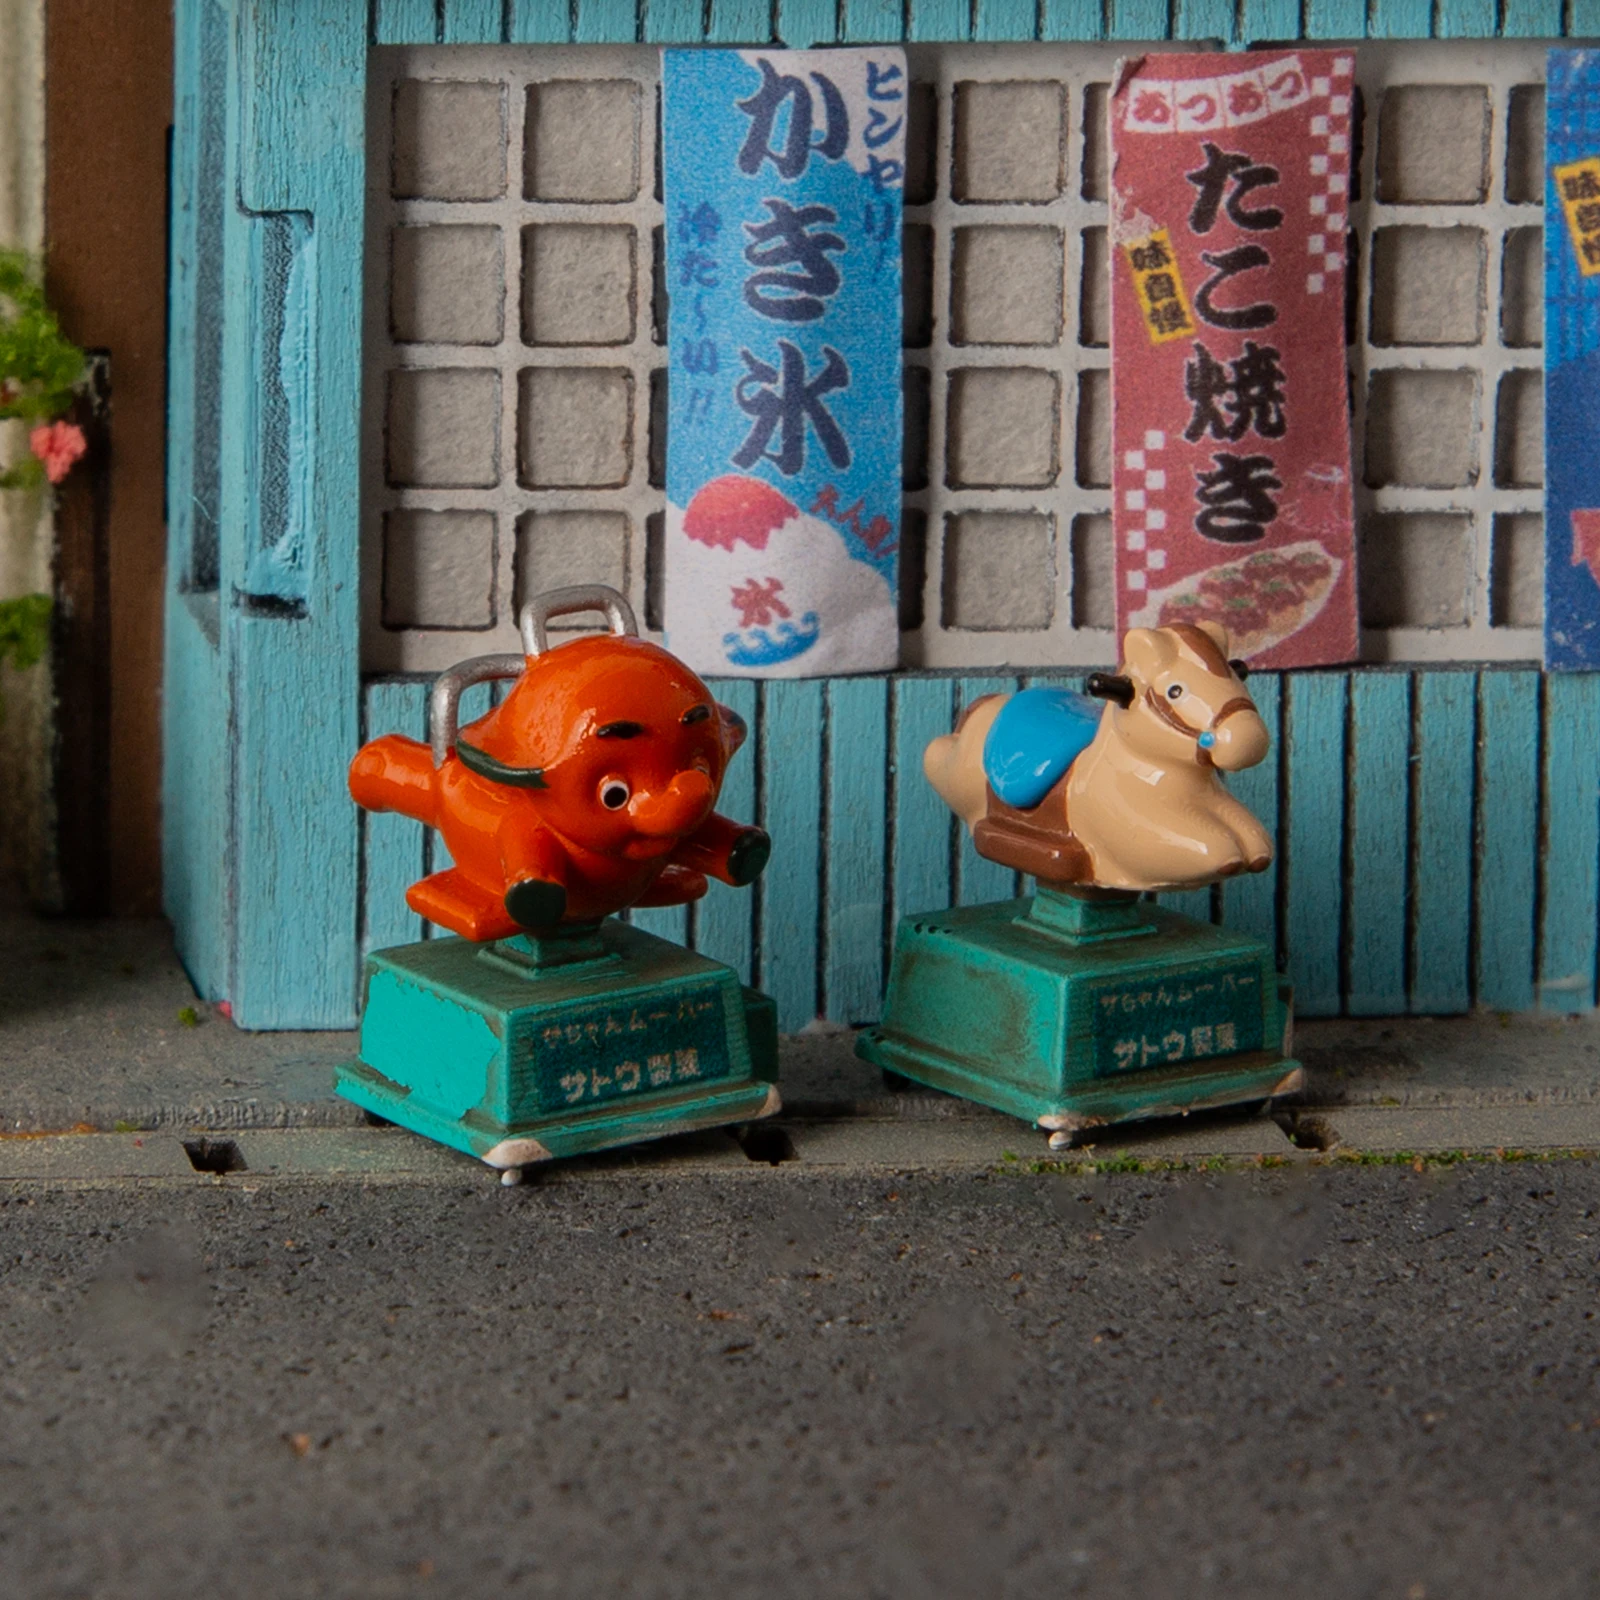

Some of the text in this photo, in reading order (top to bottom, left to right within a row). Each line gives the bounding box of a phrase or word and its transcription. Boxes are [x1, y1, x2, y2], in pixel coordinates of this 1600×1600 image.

[731, 57, 852, 476] かき氷
[1184, 141, 1287, 543] たこ焼き
[730, 576, 792, 628] 氷
